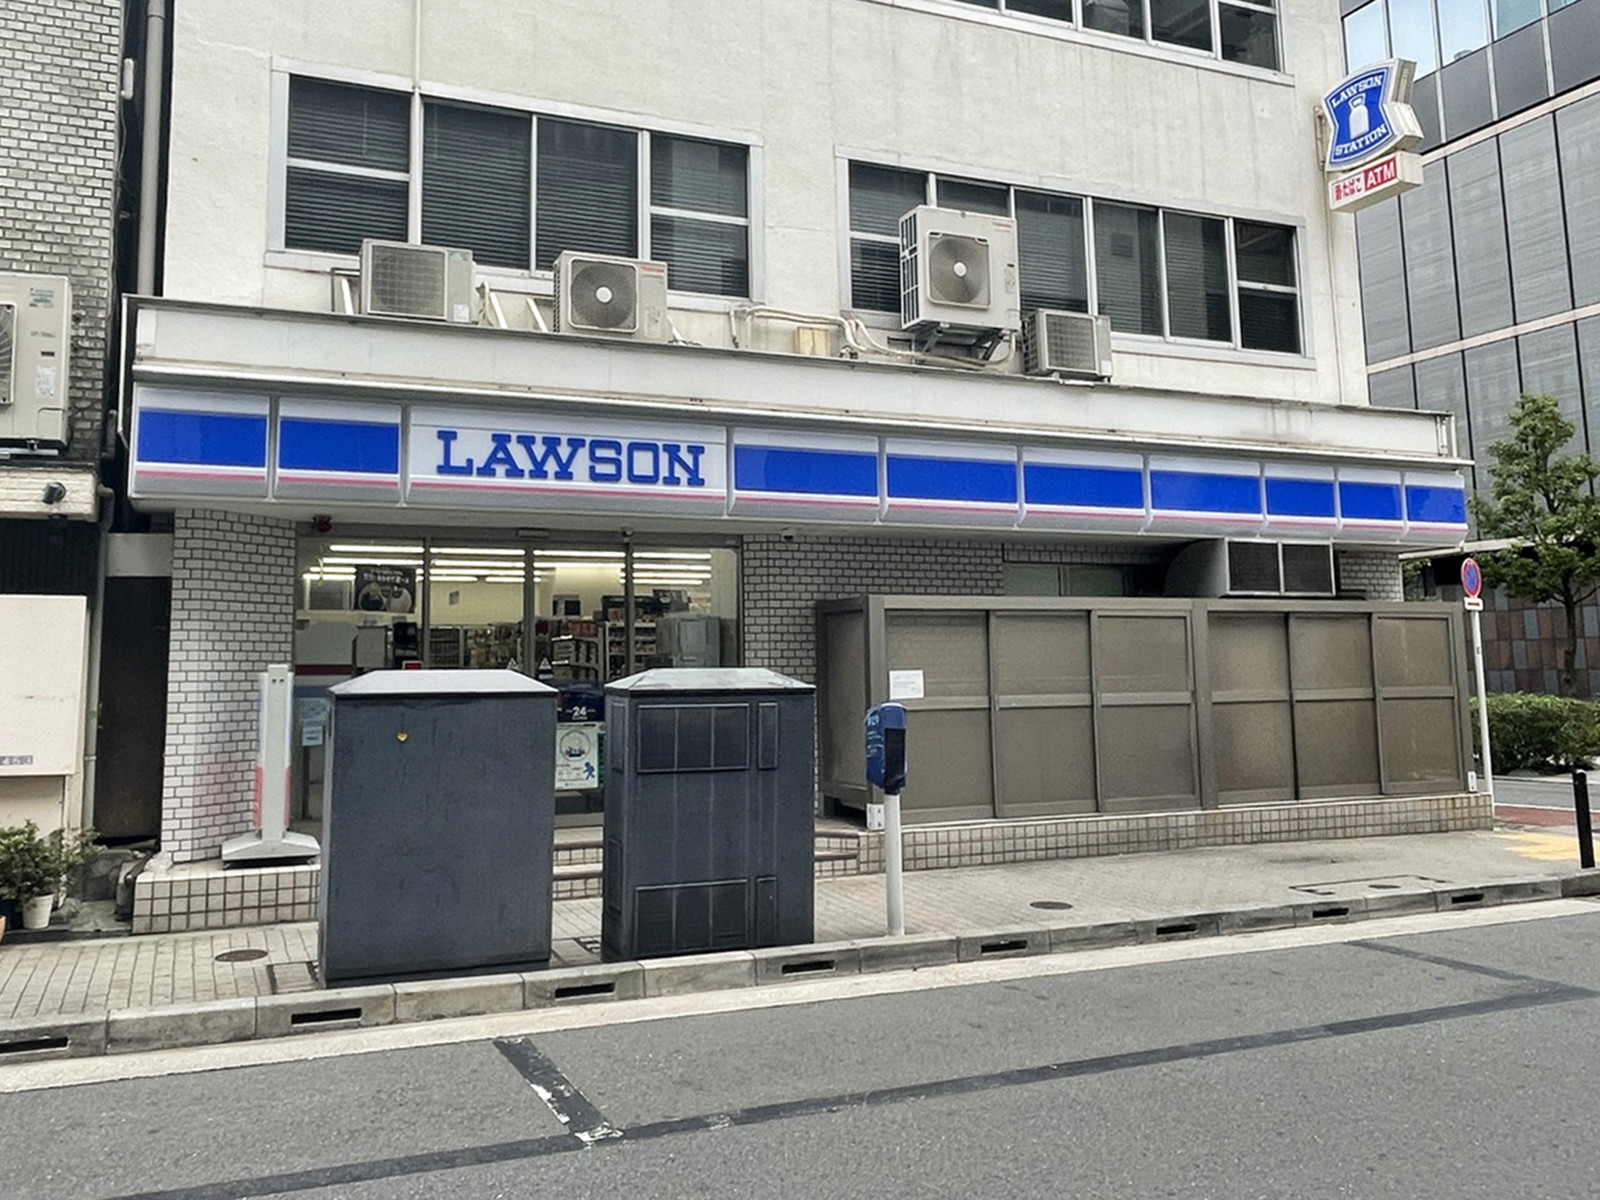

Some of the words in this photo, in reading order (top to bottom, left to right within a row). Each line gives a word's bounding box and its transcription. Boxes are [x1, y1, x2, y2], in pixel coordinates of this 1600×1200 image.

[1331, 75, 1384, 108] LAWSON
[1335, 123, 1388, 156] STATION
[1367, 160, 1396, 189] ATM
[436, 429, 706, 487] LAWSON
[572, 706, 587, 717] 24
